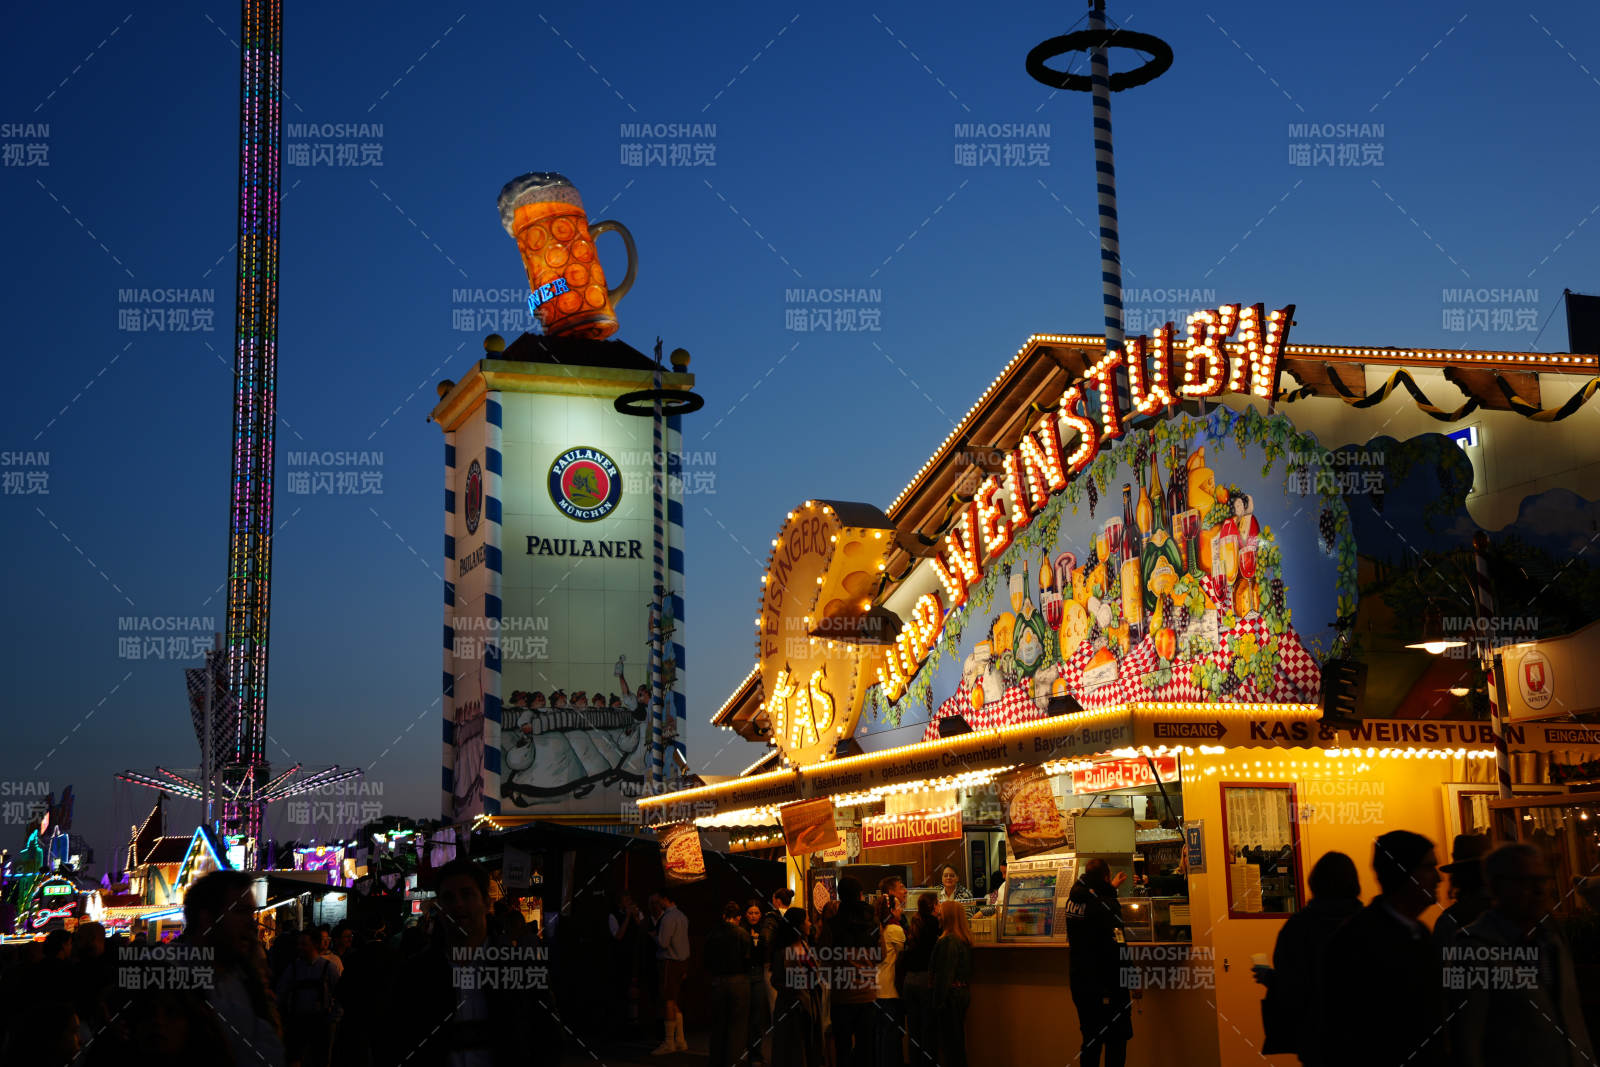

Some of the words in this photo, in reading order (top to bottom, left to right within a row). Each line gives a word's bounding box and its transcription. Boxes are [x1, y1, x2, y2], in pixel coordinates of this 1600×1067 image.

[528, 277, 570, 317] NER
[552, 448, 617, 477] PAULANER
[558, 499, 613, 519] MÜNCHEN
[525, 535, 645, 560] PAULANER
[765, 516, 829, 659] FEISINGERS
[876, 591, 945, 702] UND
[768, 664, 837, 749] KAS
[1157, 723, 1220, 738] EINGANG
[1250, 721, 1310, 741] KAS
[1349, 721, 1526, 745] WEINSTUBN
[812, 772, 863, 790] Käsekrainer
[882, 757, 940, 780] gebackener
[942, 743, 1008, 767] Camembert
[865, 815, 958, 843] Flammkuchen
